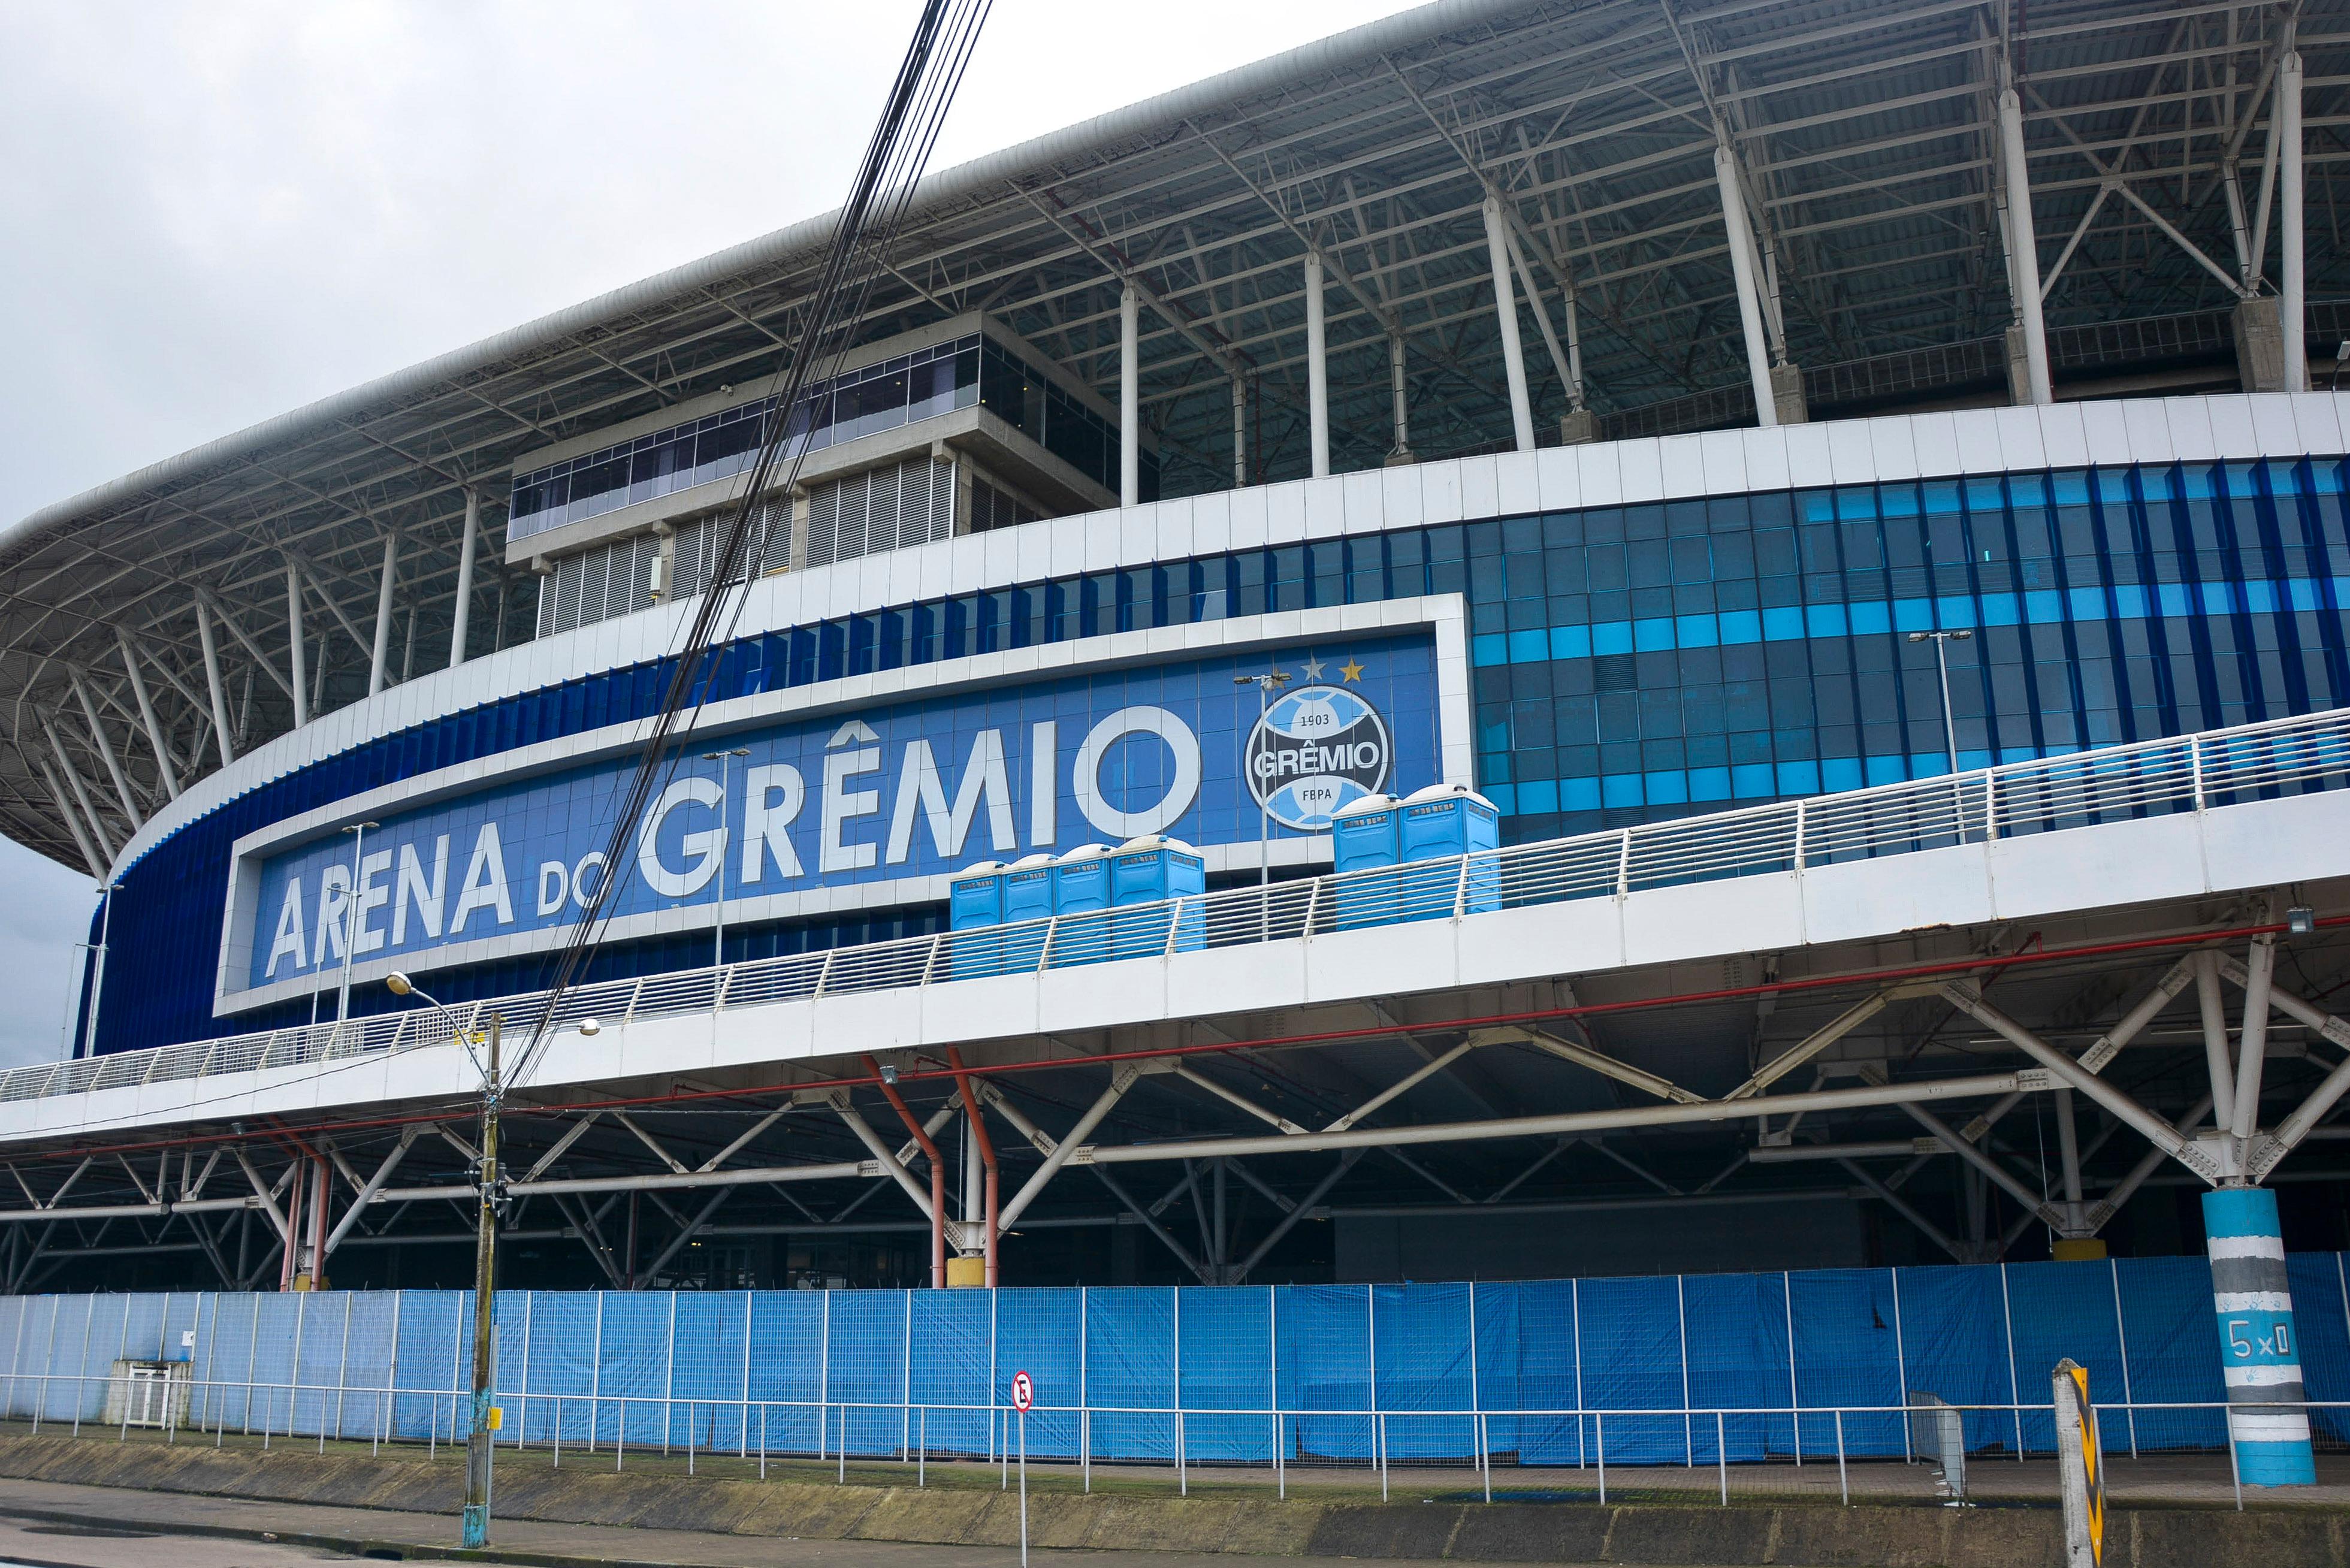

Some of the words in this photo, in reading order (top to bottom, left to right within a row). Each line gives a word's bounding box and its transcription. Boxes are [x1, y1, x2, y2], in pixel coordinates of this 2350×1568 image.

[1301, 714, 1329, 726] 1903
[1253, 739, 1380, 778] GRÊMIO
[1303, 789, 1331, 800] FBPA
[265, 821, 514, 978] ARENA
[537, 851, 611, 917] DO
[638, 704, 1201, 898] GRÊMIO
[1020, 1380, 1026, 1403] E
